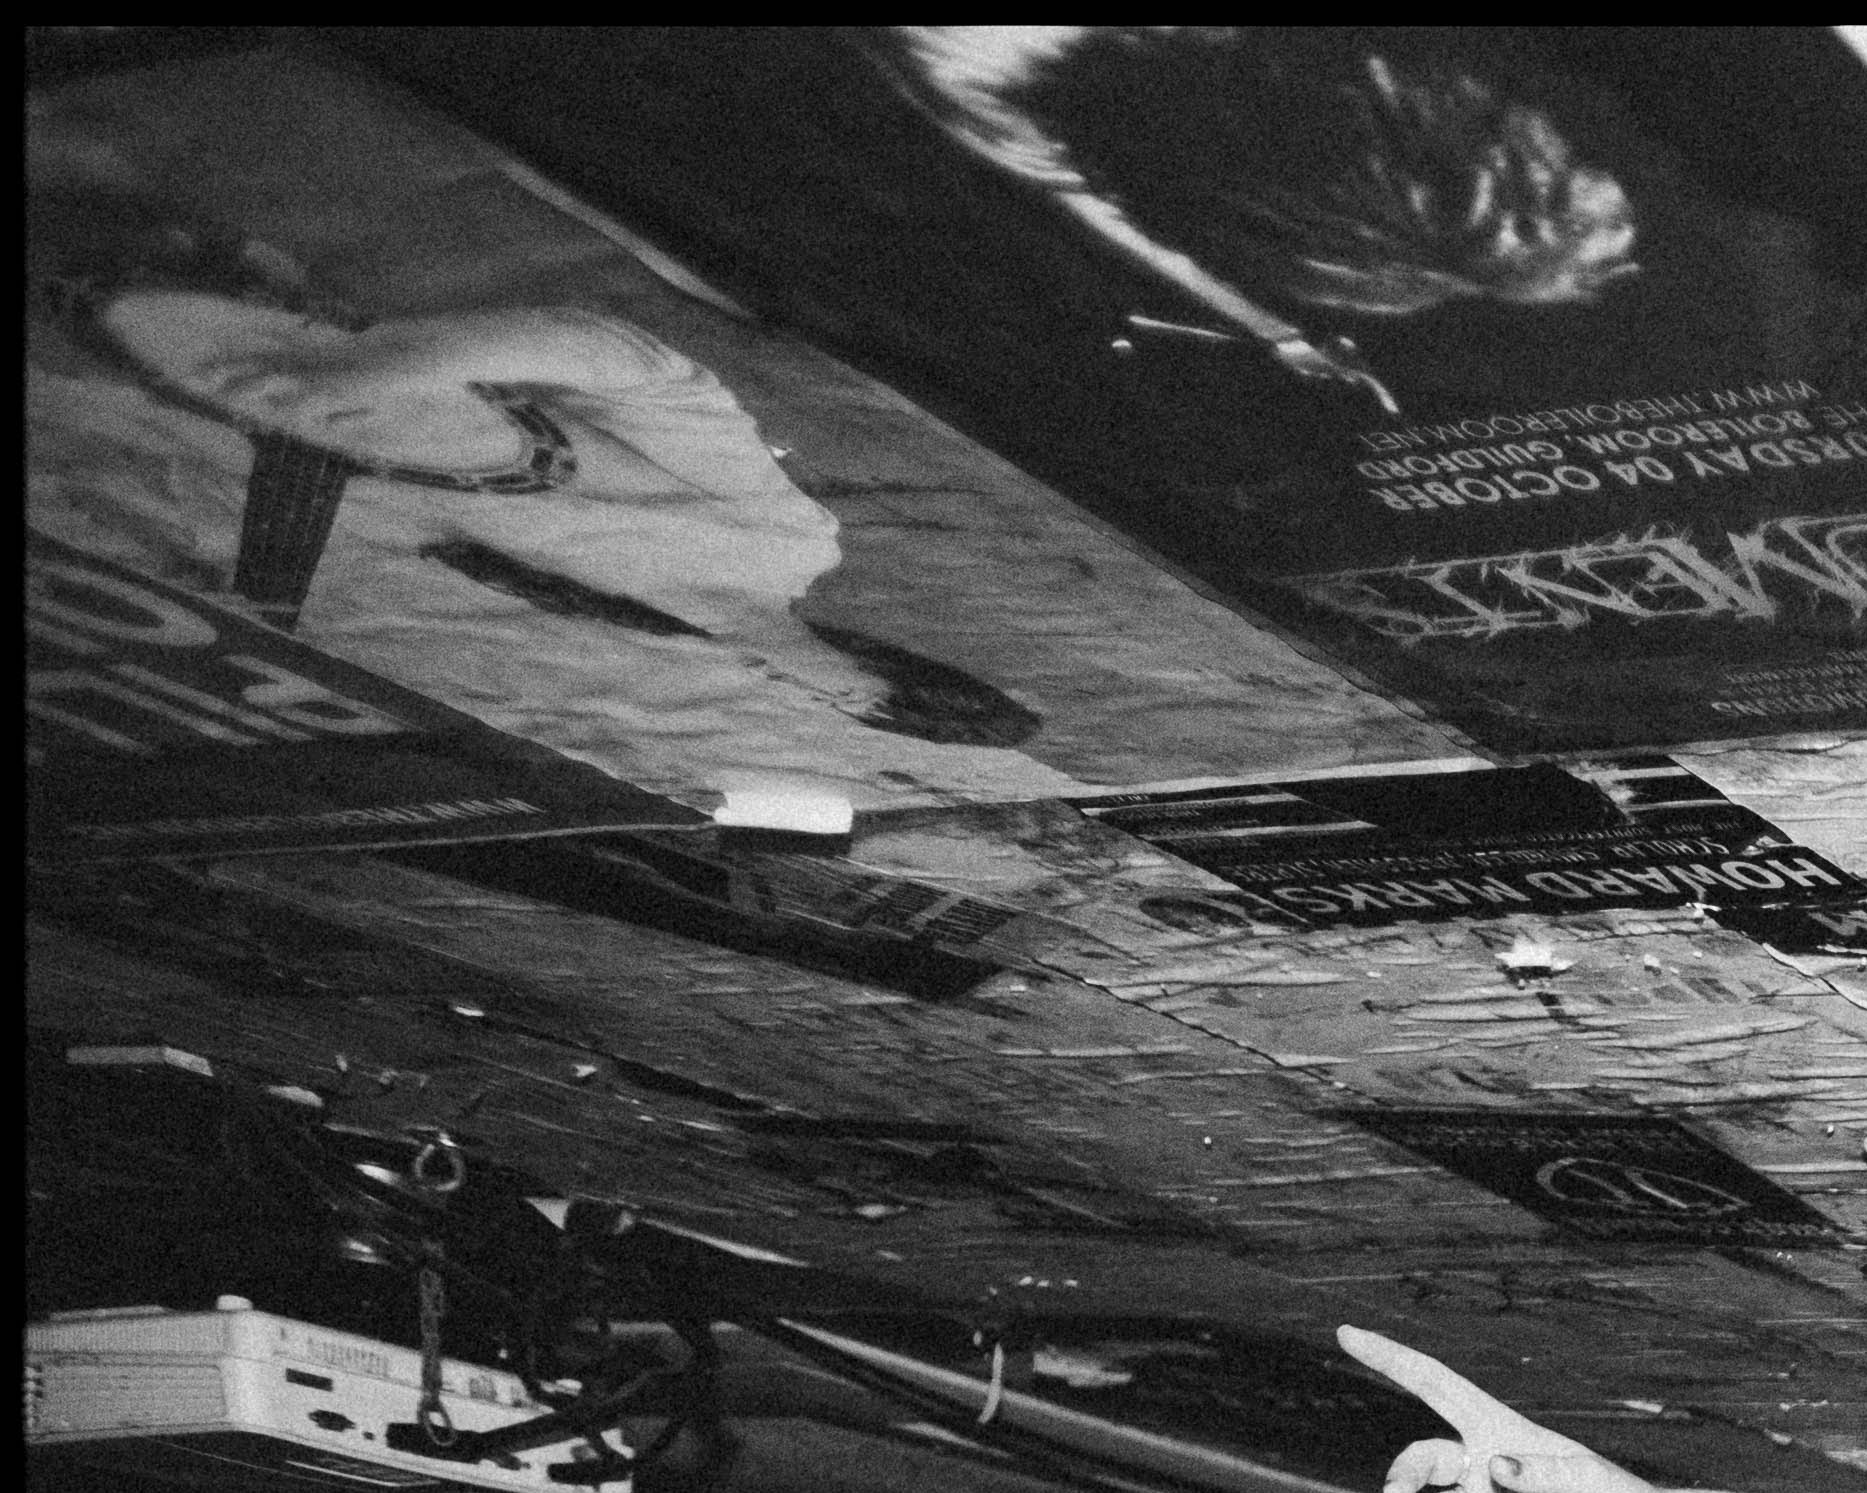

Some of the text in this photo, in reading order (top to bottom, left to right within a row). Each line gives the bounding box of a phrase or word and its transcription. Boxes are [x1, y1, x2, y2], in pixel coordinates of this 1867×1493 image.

[1357, 380, 1820, 452] WWW.THEBOILEROOM.NET
[1356, 439, 1565, 482] GUILDFORD
[1603, 455, 1674, 488] 04
[1366, 463, 1600, 512] OCTOBER
[1270, 856, 1842, 915] HOWARD MARKS
